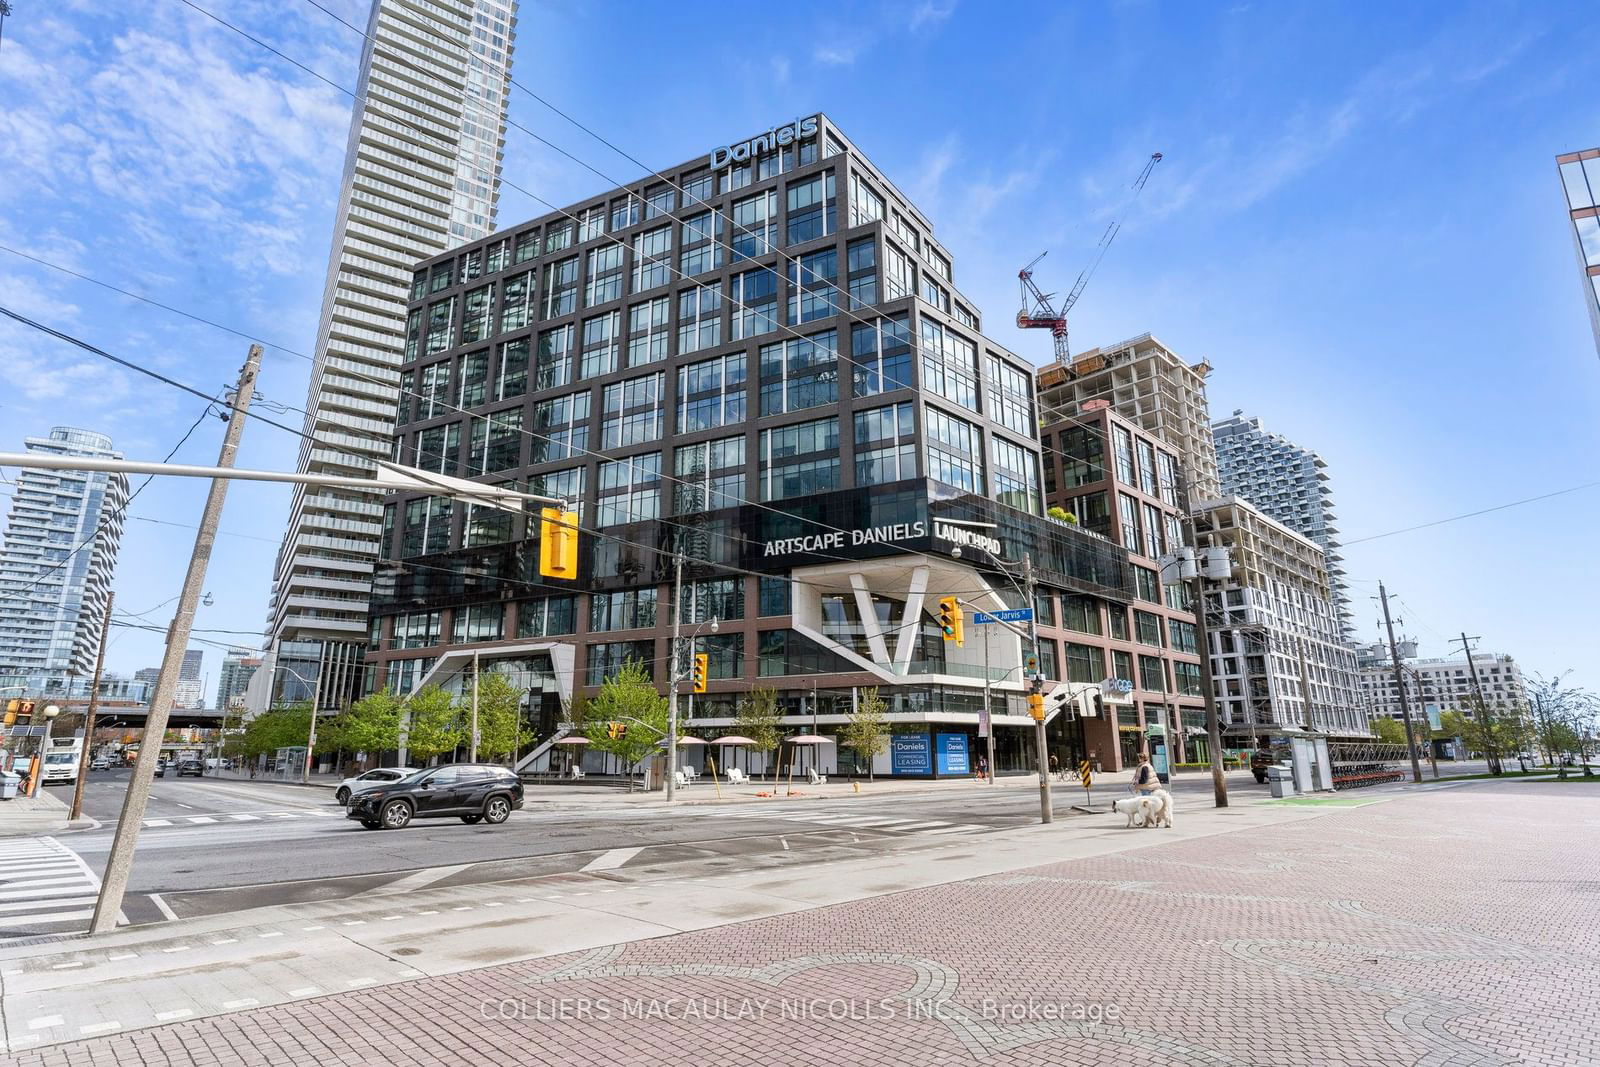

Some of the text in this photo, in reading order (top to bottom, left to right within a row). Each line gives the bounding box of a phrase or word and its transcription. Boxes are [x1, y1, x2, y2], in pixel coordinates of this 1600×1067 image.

[710, 117, 818, 170] Daniels
[764, 521, 925, 556] ARTSCAPE DANIELS
[934, 521, 1001, 555] LAUNCHPAD
[1001, 610, 1021, 620] Jarvis
